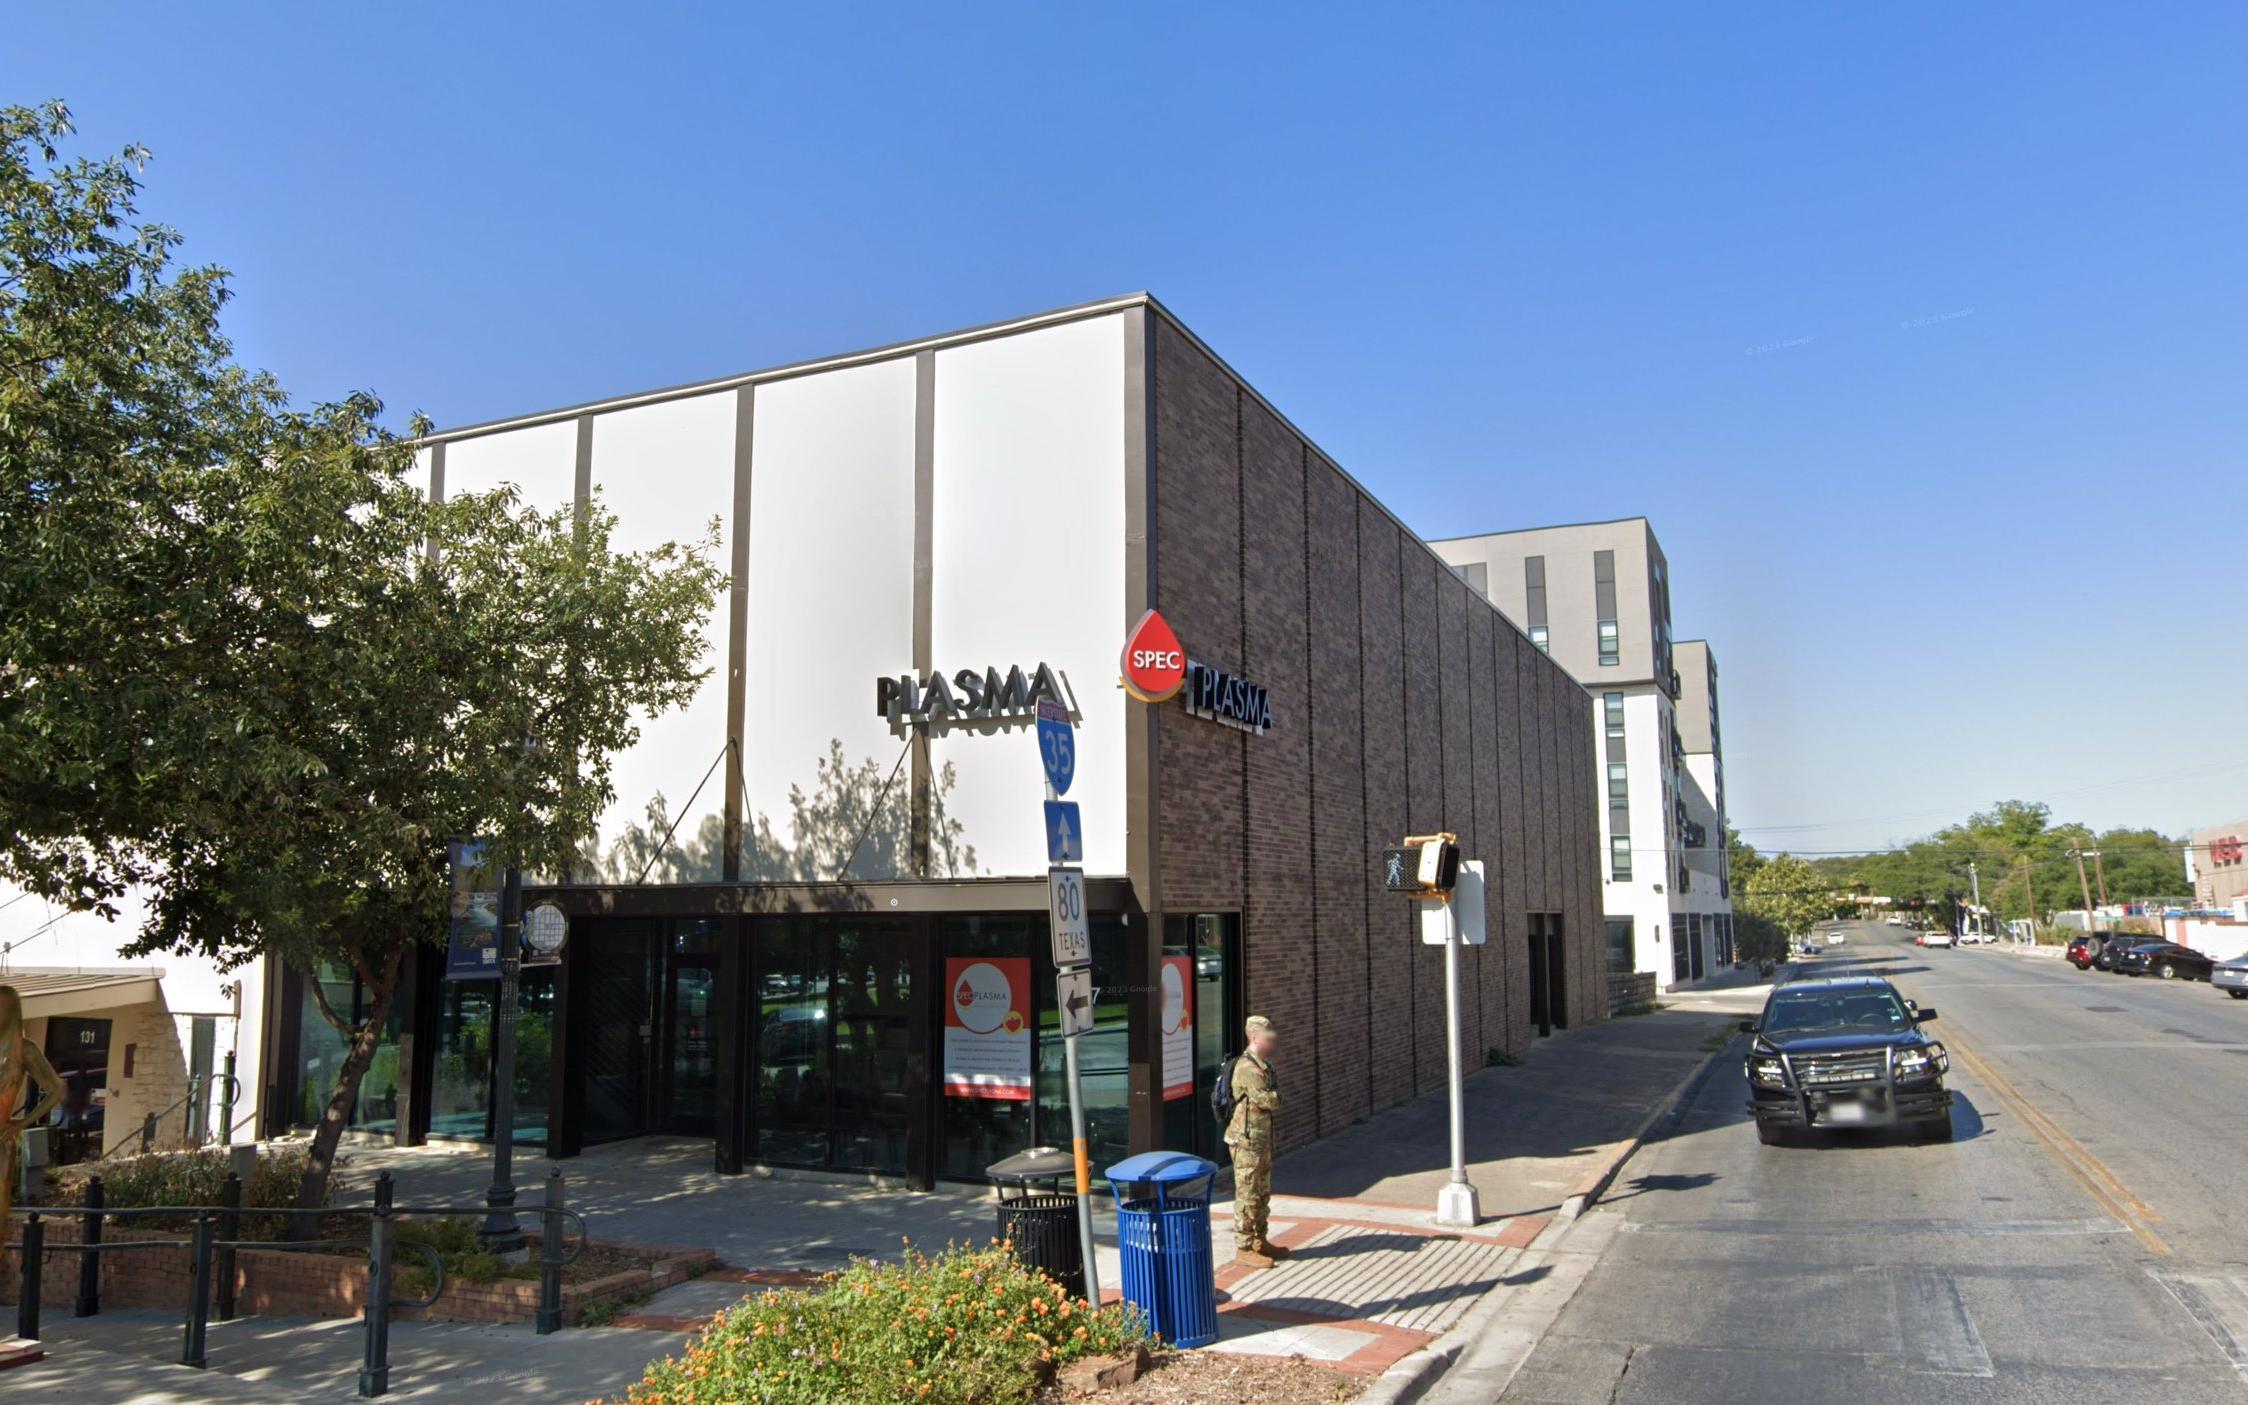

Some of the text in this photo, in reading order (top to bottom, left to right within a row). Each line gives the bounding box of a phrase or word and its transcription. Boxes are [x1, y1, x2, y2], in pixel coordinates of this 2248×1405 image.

[1133, 650, 1180, 669] SPEC
[877, 661, 1064, 720] PLASMA
[1199, 665, 1272, 729] PLASMA
[1045, 730, 1072, 775] 35
[1058, 882, 1080, 922] 80
[1058, 931, 1086, 950] TEXAS
[974, 991, 1007, 1001] PLASMA
[80, 1030, 95, 1044] 131
